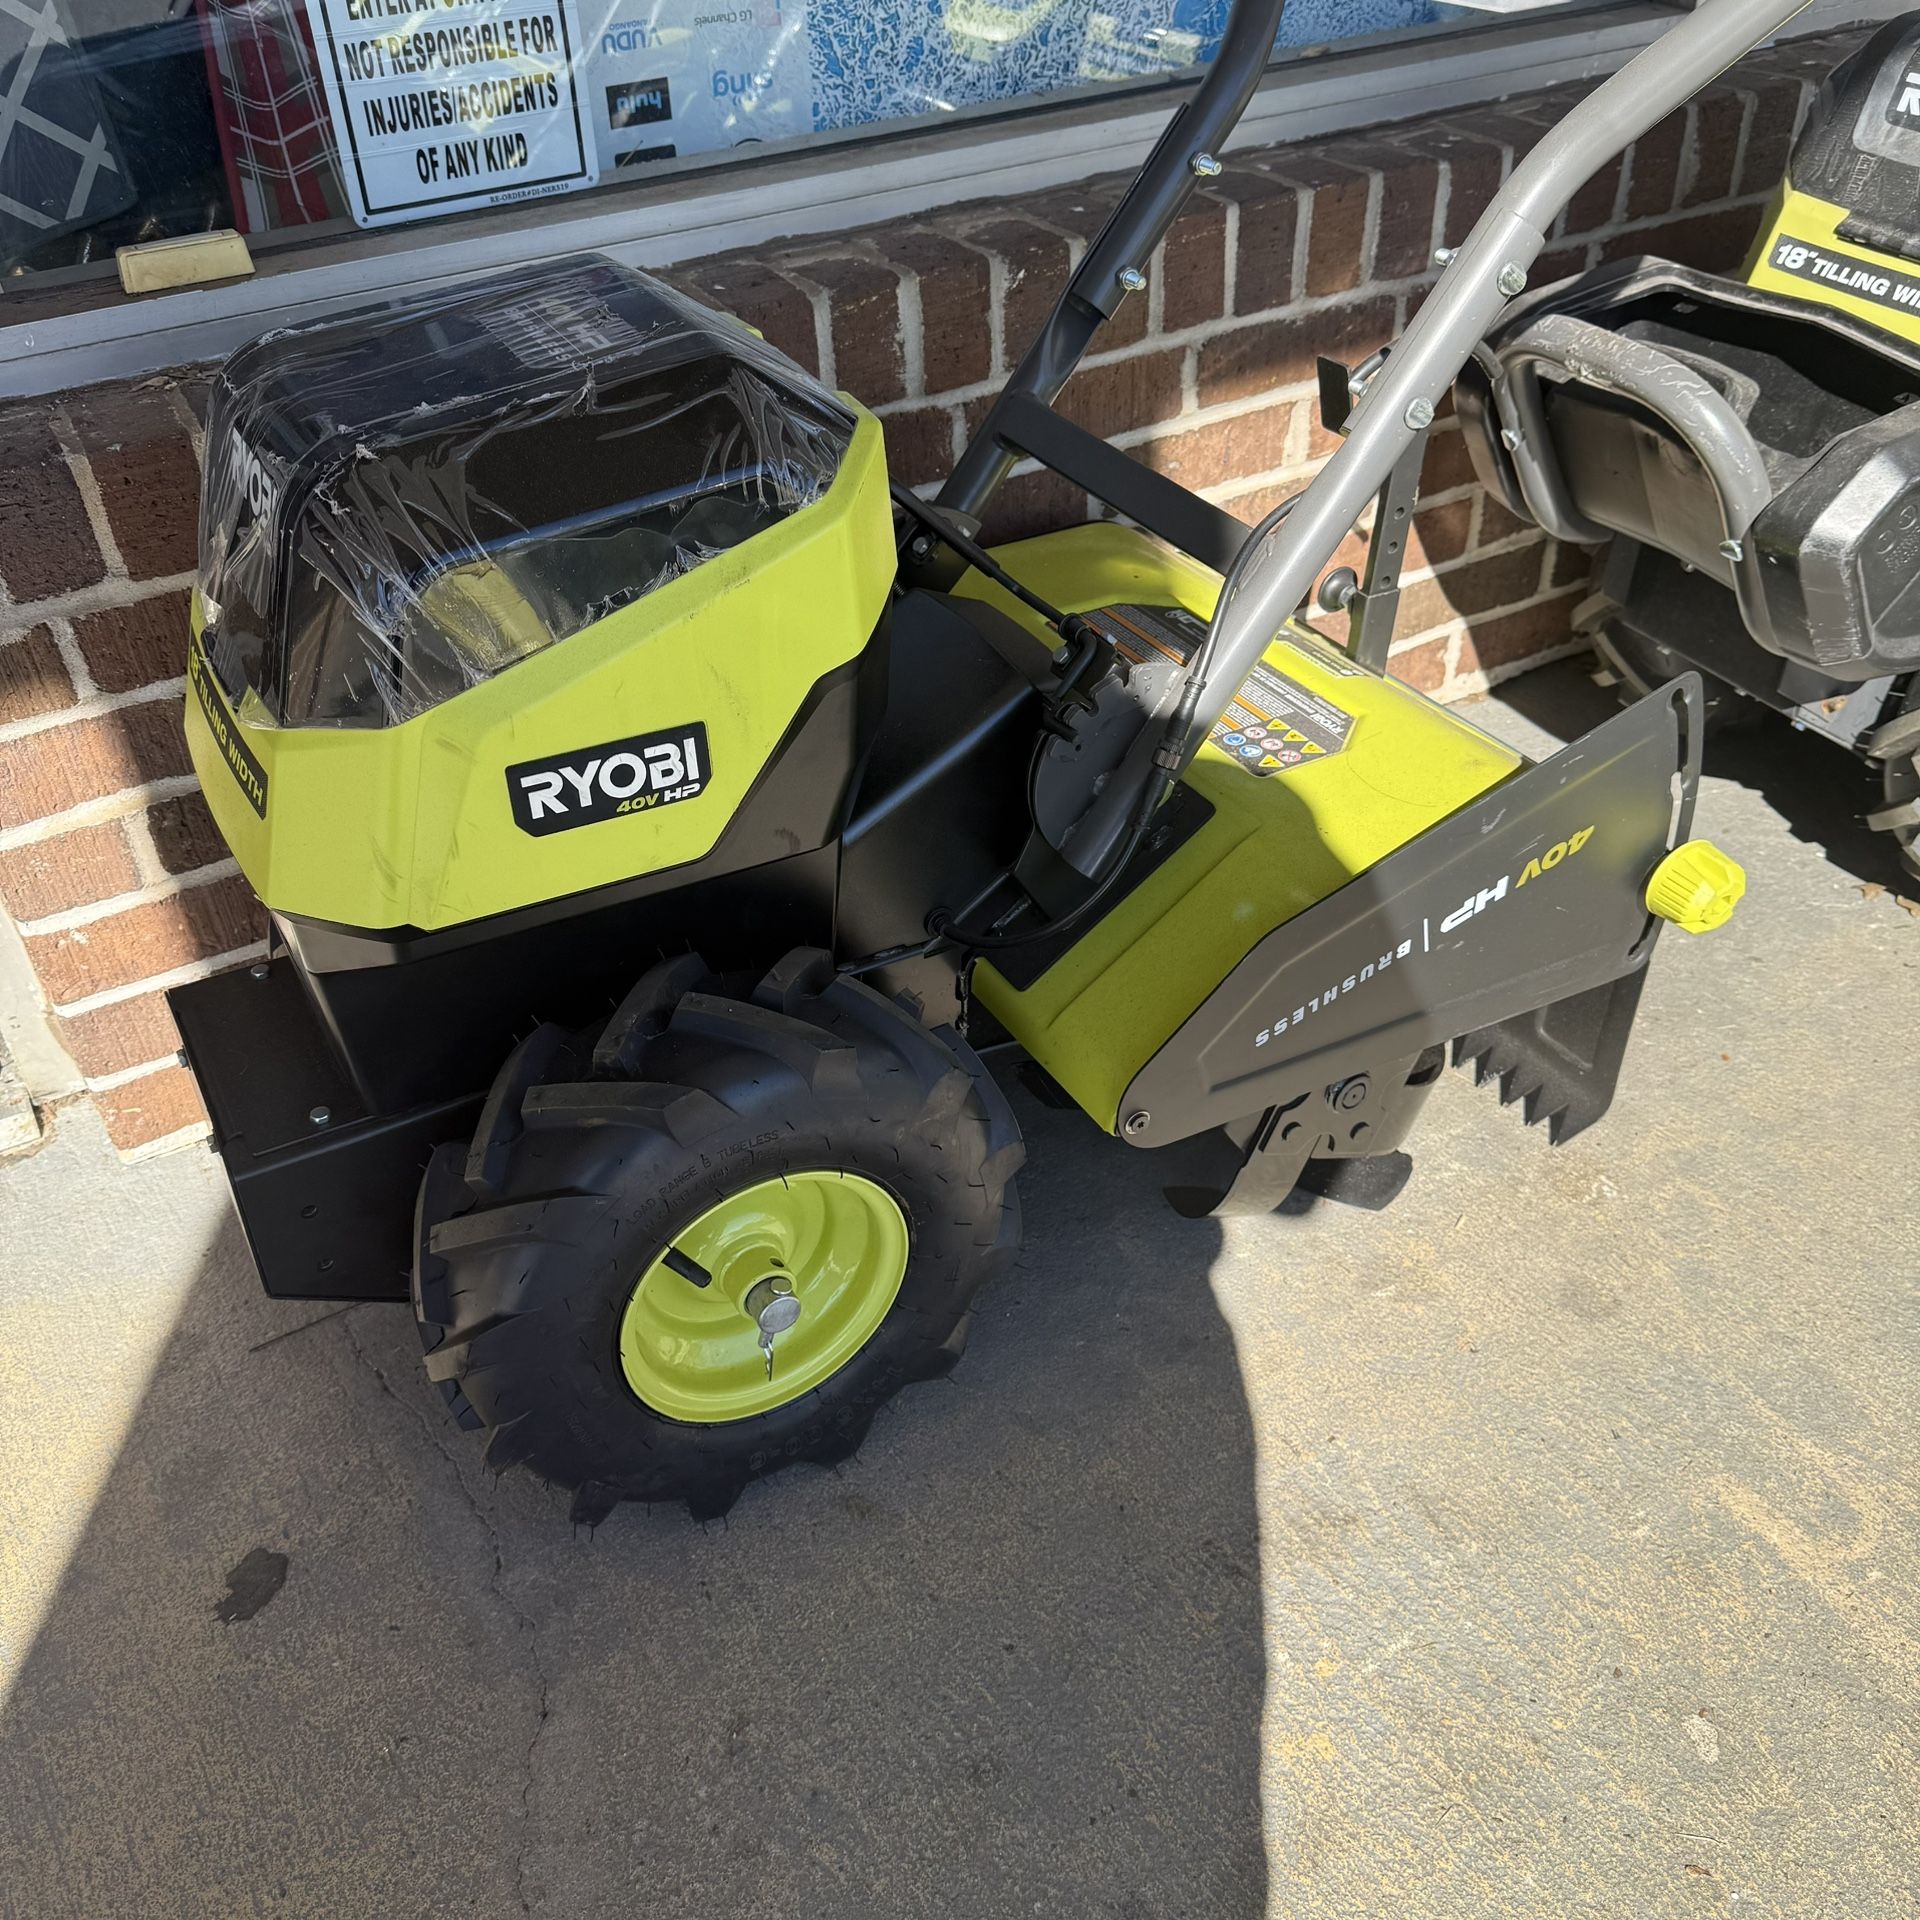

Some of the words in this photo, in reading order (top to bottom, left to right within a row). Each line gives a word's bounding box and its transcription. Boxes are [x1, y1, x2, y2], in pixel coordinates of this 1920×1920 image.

[602, 27, 663, 54] VUDU
[693, 11, 737, 28] Channels
[738, 9, 753, 22] LG
[343, 38, 385, 81] NOT
[387, 20, 518, 75] RESPONSIBLE
[519, 15, 558, 55] FOR
[363, 72, 559, 137] INJURIES/ACCIDENTS
[615, 90, 662, 112] hulu
[416, 147, 439, 184] OF
[446, 140, 480, 180] ANY
[483, 132, 528, 173] KIND
[1812, 258, 1890, 296] TILLING
[200, 678, 227, 746] TILLING
[229, 738, 264, 807] WIDTH
[519, 737, 700, 820] RYOBI
[616, 792, 659, 814] 40V
[663, 782, 700, 803] HP
[1514, 824, 1595, 889] 40V
[1440, 875, 1510, 934] HP
[1255, 939, 1411, 1048] BRUSHLESS
[658, 1165, 699, 1198] RANGE
[716, 1129, 780, 1161] TUBELESS
